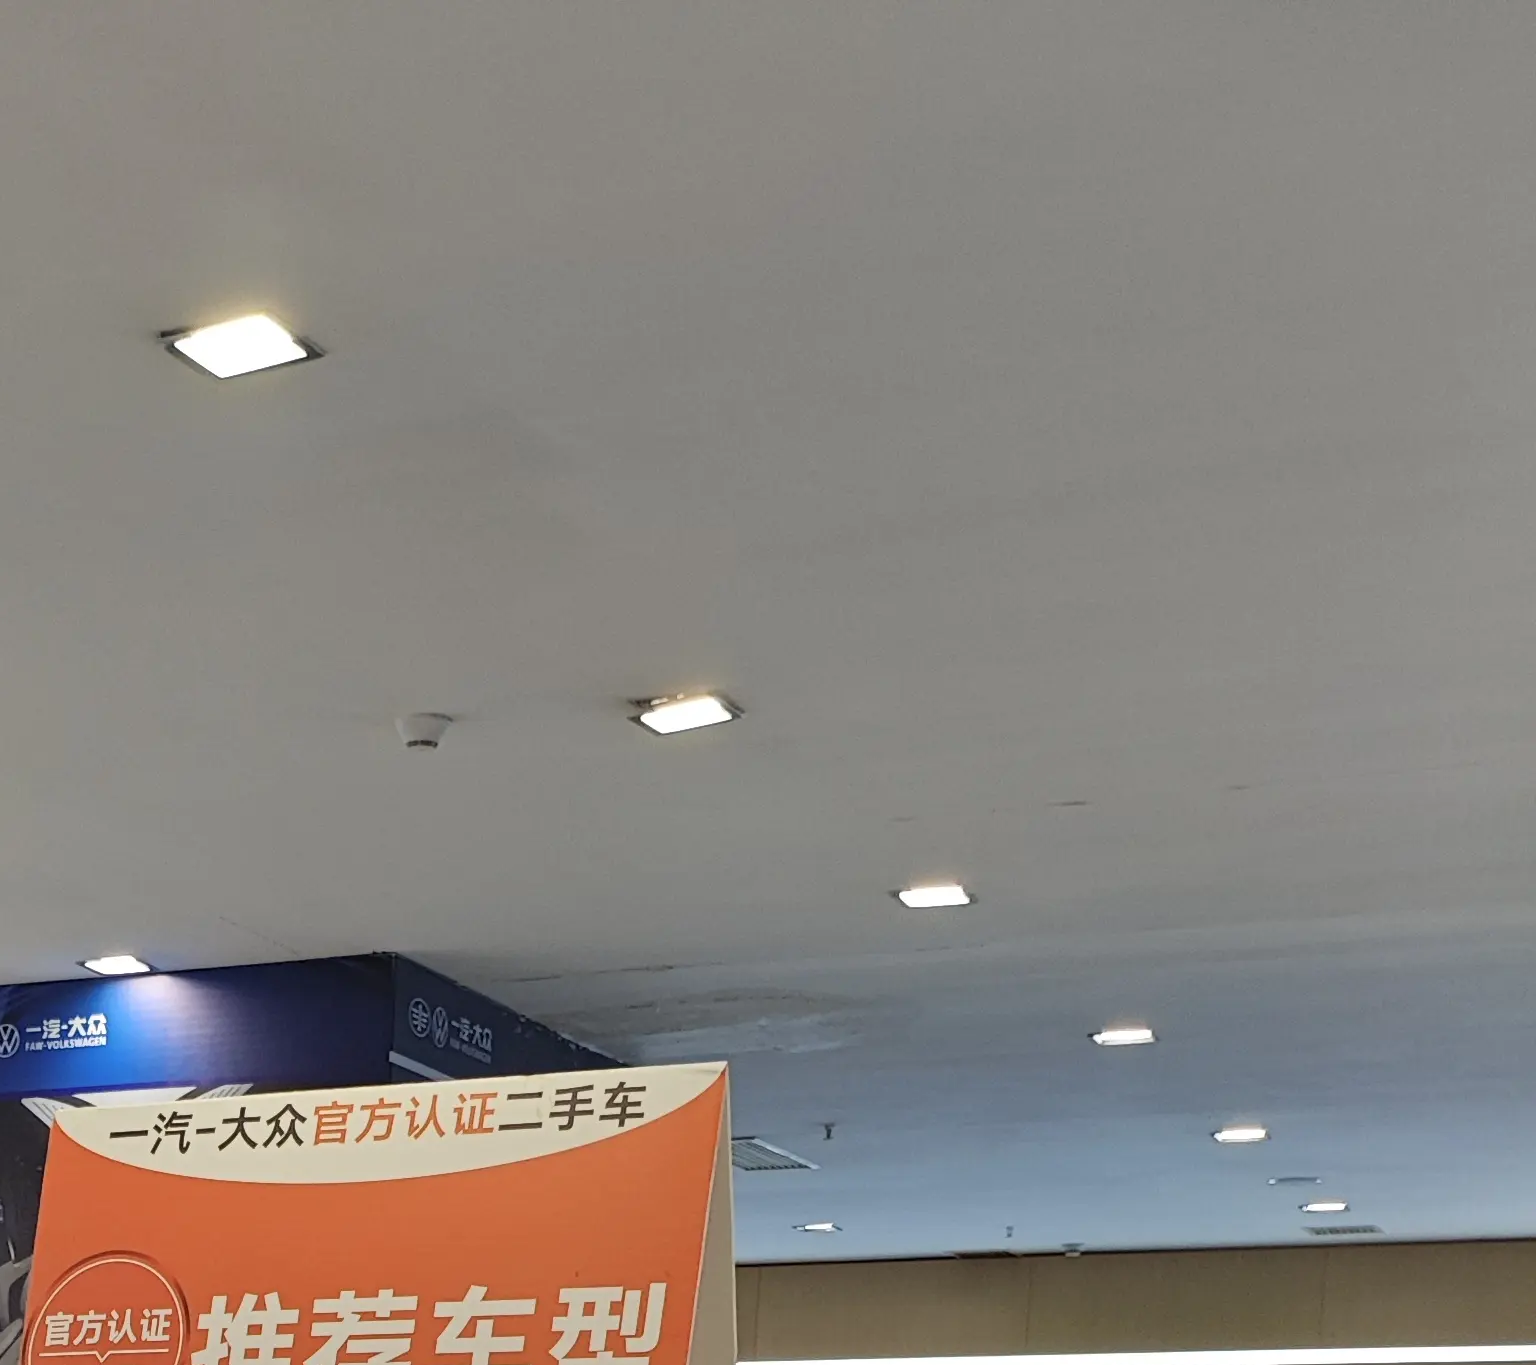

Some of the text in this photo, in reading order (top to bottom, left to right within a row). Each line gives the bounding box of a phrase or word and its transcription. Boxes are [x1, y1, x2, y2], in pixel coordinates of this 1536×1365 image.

[25, 1037, 107, 1052] FAW-VOLKSWAGEN
[109, 1081, 647, 1155] 一汽-大众官方认证二手车
[43, 1308, 171, 1347] 官方认证
